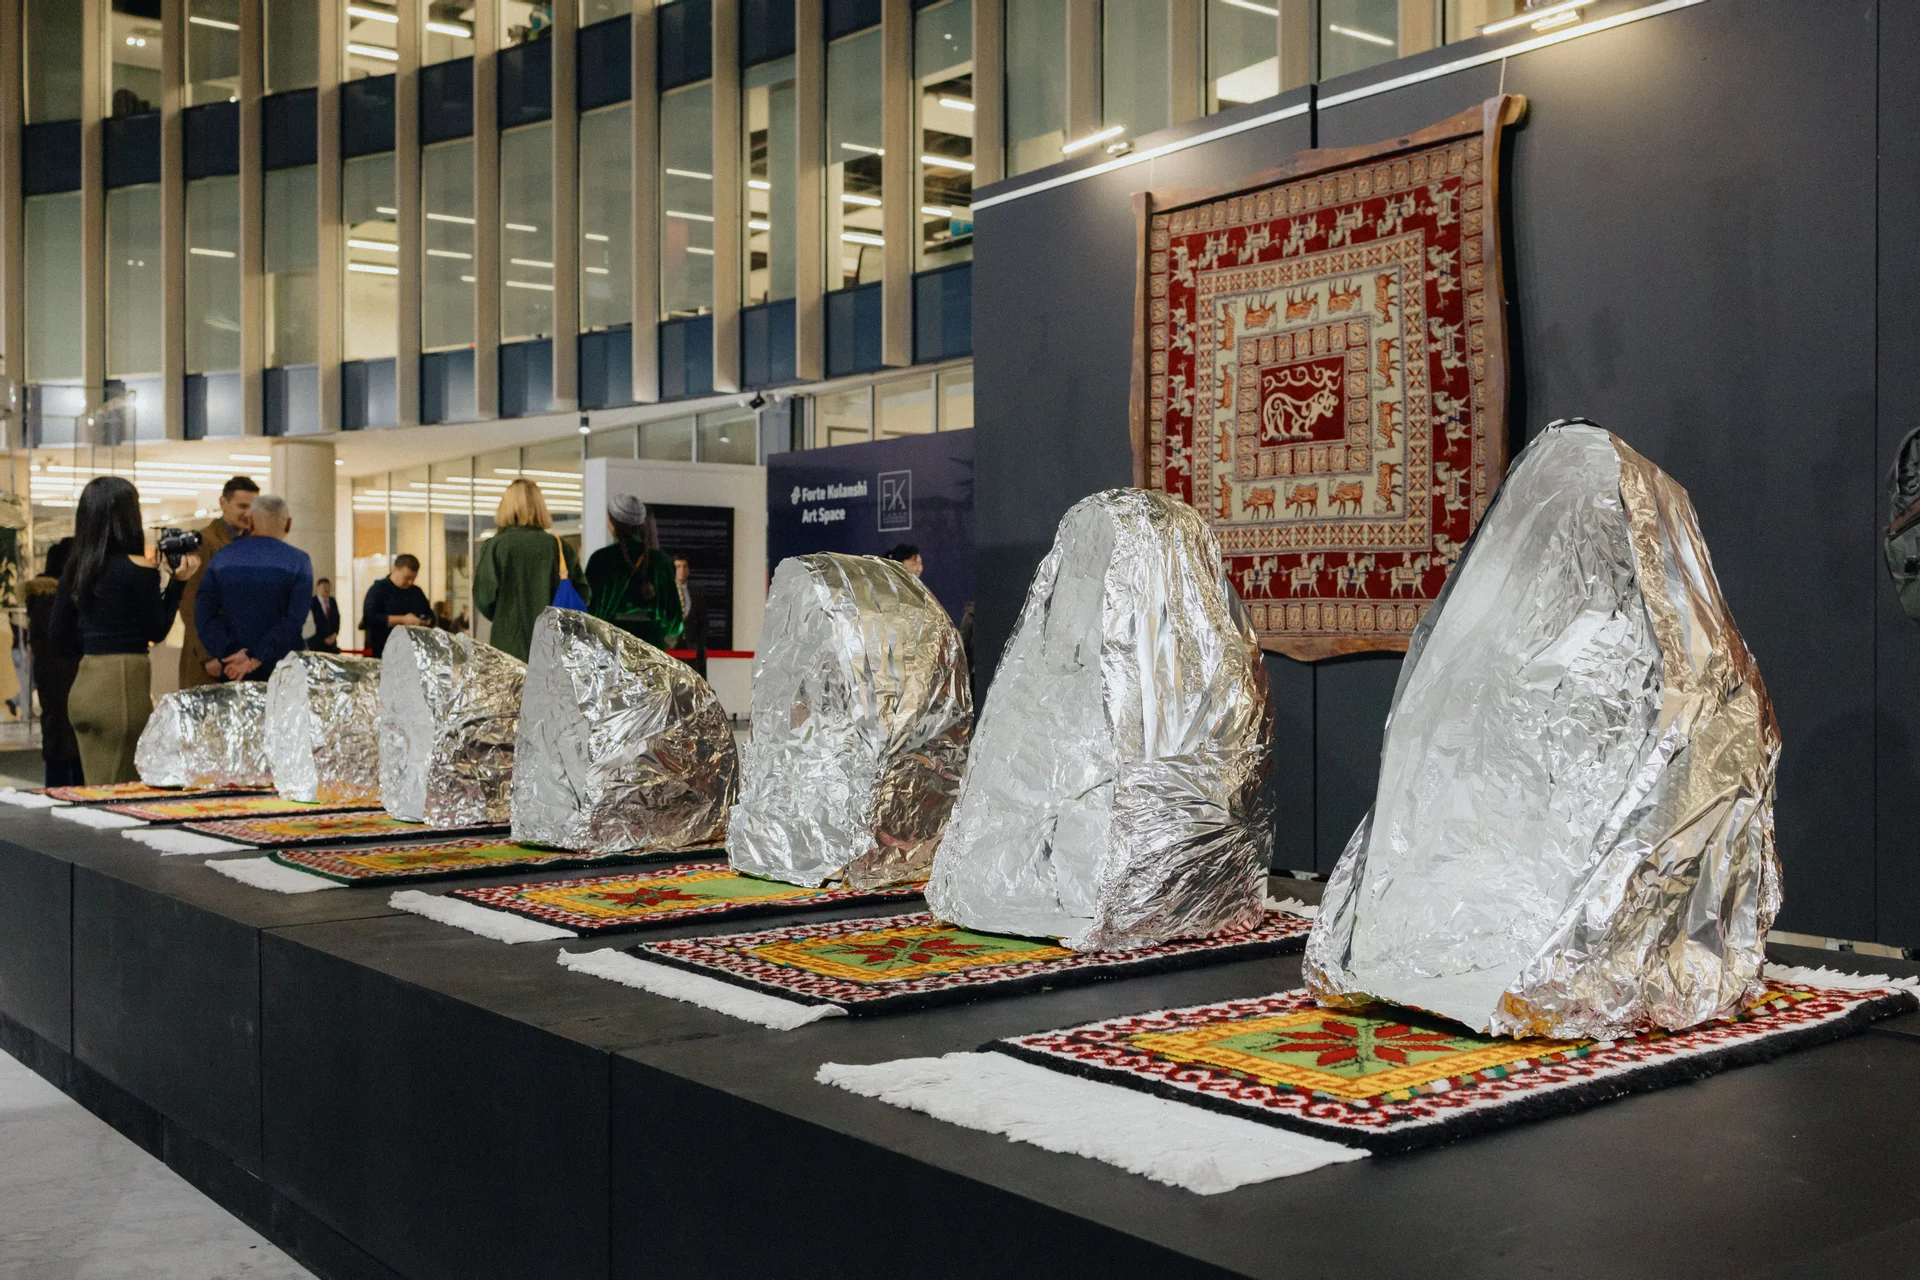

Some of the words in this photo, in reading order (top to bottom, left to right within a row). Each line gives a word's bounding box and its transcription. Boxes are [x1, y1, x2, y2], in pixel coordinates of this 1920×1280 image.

[802, 487, 826, 502] Forte
[827, 480, 867, 499] Kulanshi
[802, 509, 817, 524] Art
[818, 507, 846, 525] Space
